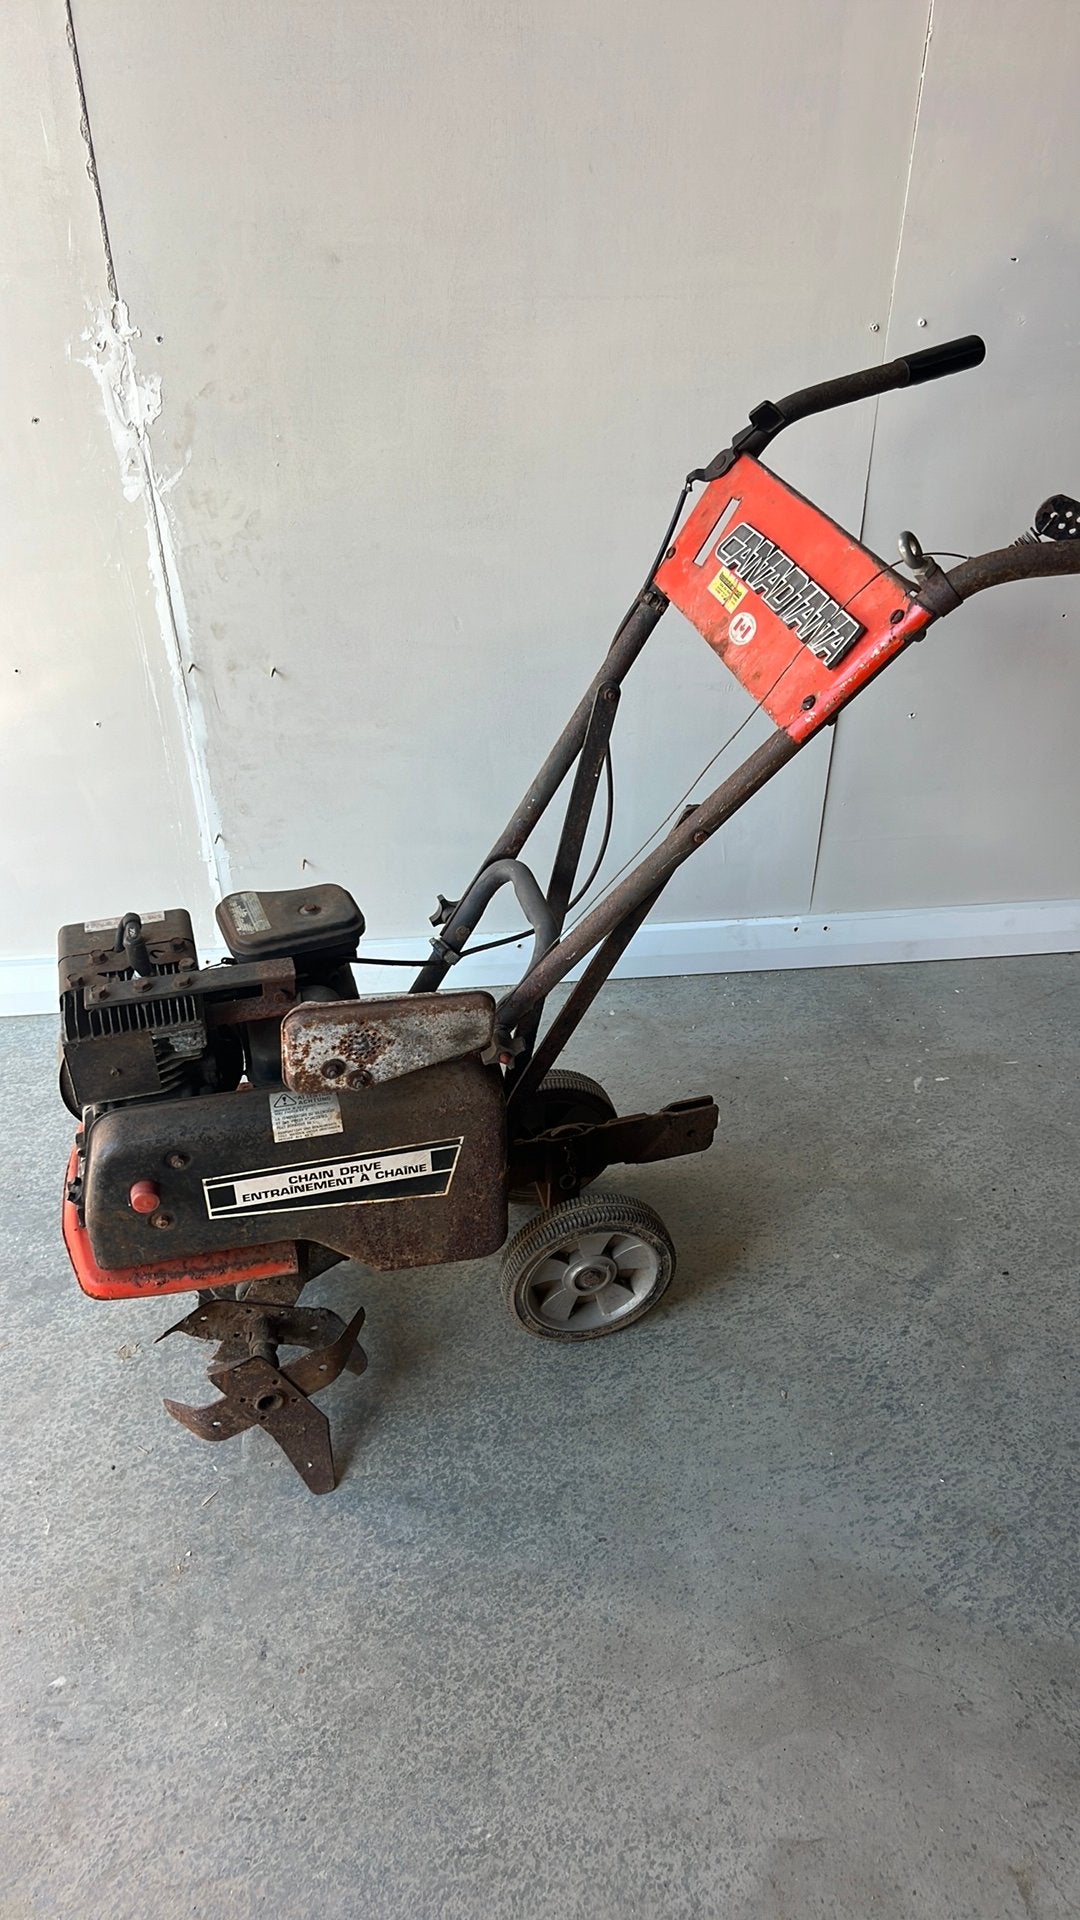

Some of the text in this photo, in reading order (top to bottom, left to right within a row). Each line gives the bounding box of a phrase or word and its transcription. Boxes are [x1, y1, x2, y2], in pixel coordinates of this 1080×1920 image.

[715, 522, 861, 667] CANADIANA
[242, 1163, 427, 1202] ENTRAÎNEMENT À CHAÎNE
[288, 1161, 382, 1185] CHAIN DRIVE
